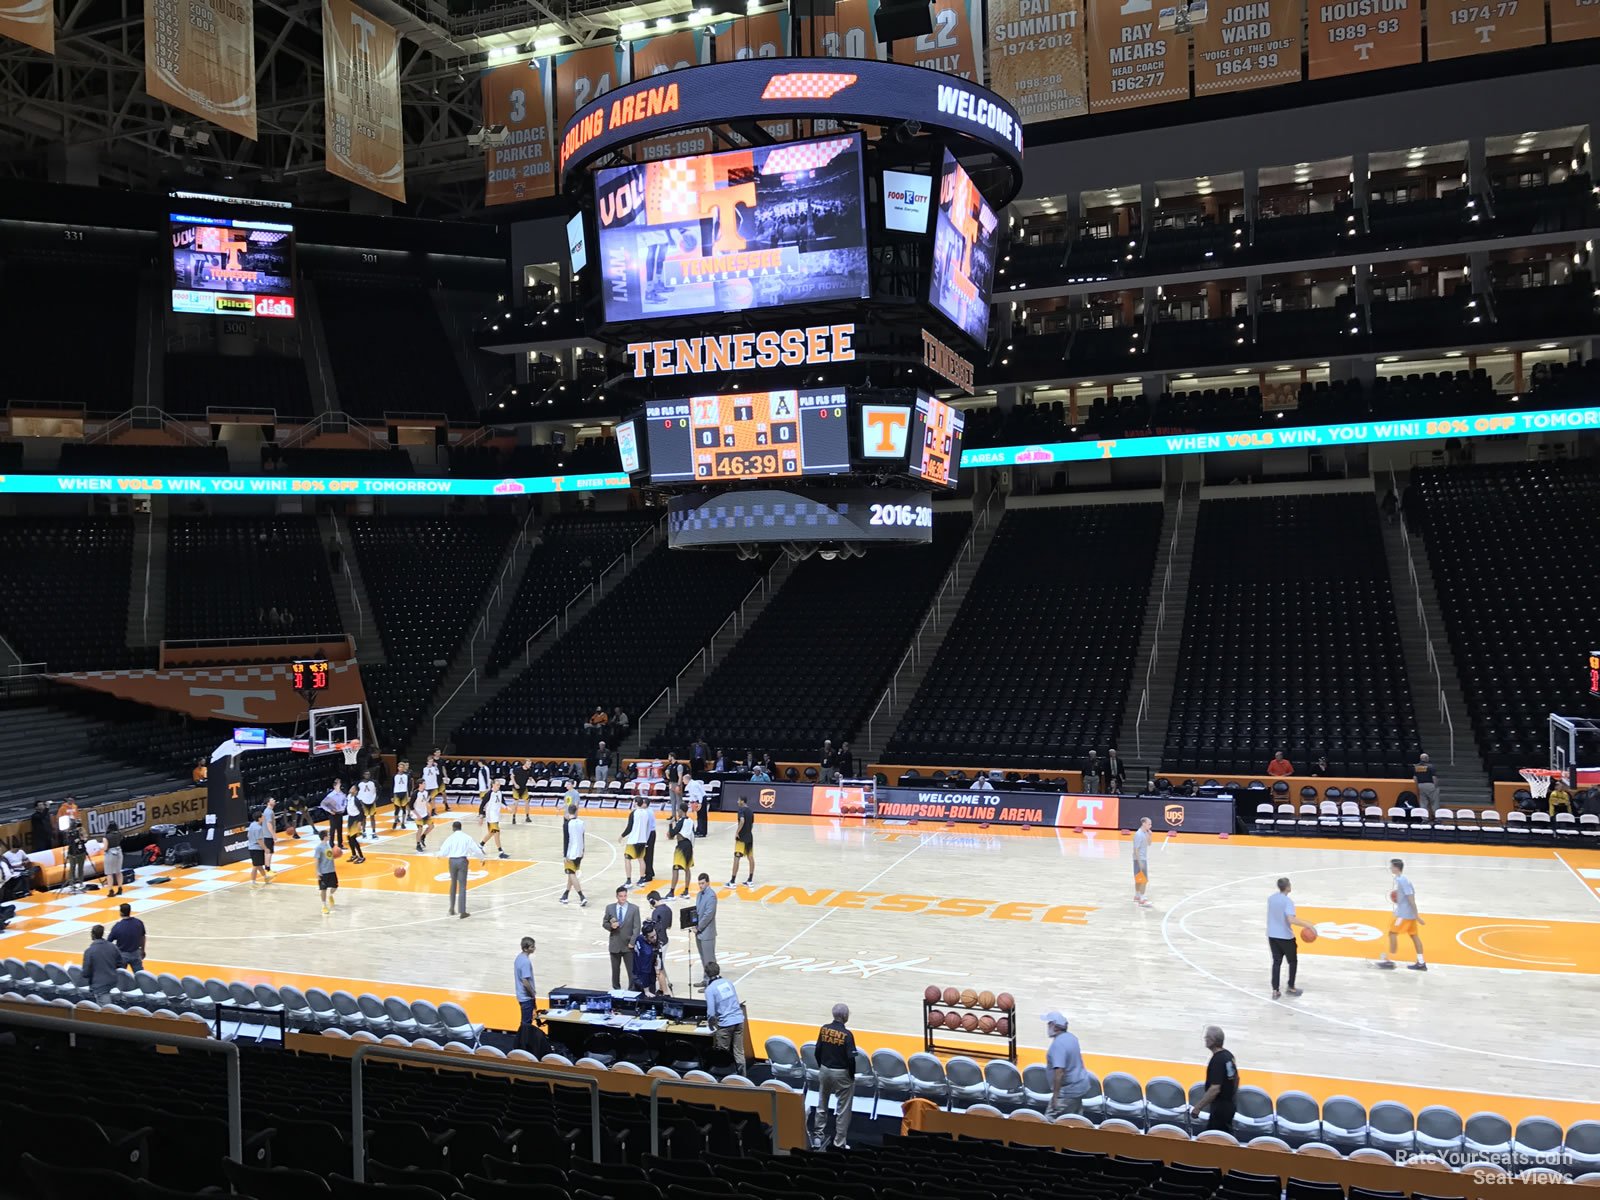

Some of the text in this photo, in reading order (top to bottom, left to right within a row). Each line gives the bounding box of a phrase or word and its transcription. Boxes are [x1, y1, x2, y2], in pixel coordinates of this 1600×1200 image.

[1222, 2, 1269, 25] JOHN
[1321, 0, 1407, 23] HOUSTON
[1450, 1, 1518, 24] 1974-77
[995, 11, 1077, 41] SUMMITT
[1121, 23, 1153, 43] RAY
[1221, 22, 1271, 44] WARD
[1328, 18, 1399, 42] 1989-93
[1003, 33, 1072, 57] 1974-2012
[1109, 41, 1166, 64] MEARS
[1234, 46, 1246, 57] OF
[1248, 44, 1265, 55] THE
[1112, 60, 1164, 77] HEAD COACH
[1215, 54, 1279, 76] 1964-99
[1110, 72, 1165, 94] 1962-77
[509, 89, 526, 122] 3
[609, 83, 679, 130] ARENA
[938, 84, 1012, 141] WELCOME
[1017, 97, 1081, 117] MPIONSHIPS
[489, 126, 545, 148] NDACE
[496, 143, 542, 164] PARKER
[888, 191, 904, 200] FOOD
[914, 194, 927, 203] CITY
[700, 182, 757, 252] T
[64, 230, 83, 240] 331
[361, 253, 377, 262] 301
[680, 249, 782, 278] TENNESSEE
[670, 265, 795, 286] BASKETBALL
[257, 298, 293, 316] dish
[225, 322, 246, 334] 300
[627, 323, 855, 378] TENNESSEE
[740, 407, 748, 421] 1
[775, 396, 791, 415] A
[820, 407, 842, 419] 0 0
[664, 418, 687, 429] 0 0
[779, 426, 790, 441] 0
[867, 412, 906, 452] T
[702, 431, 712, 445] 0
[725, 436, 734, 447] 4
[757, 434, 766, 444] 4
[1166, 435, 1220, 451] WHEN
[1226, 432, 1274, 447] VOLS
[1280, 429, 1322, 444] WIN,
[1328, 427, 1367, 441] YOU
[1374, 424, 1420, 438] WIN!
[1425, 420, 1468, 435] 50%
[1474, 417, 1516, 431] OFF
[718, 455, 776, 475] 46:39
[786, 460, 795, 471] 0
[971, 452, 1004, 463] AREAS
[699, 465, 707, 476] 0
[58, 478, 452, 492] WHEN VOLS WIN, YOU WIN! 50% OFF TOMORROW
[576, 478, 604, 488] ENTER
[312, 672, 326, 688] 30
[189, 687, 276, 720] T
[227, 782, 241, 799] T
[918, 792, 1000, 806] WELCOME TO
[151, 797, 207, 819] BASKET
[825, 790, 848, 813] T
[877, 802, 1043, 822] THOMPSON-BOLING ARENA
[1076, 799, 1103, 826] T
[1166, 811, 1182, 823] ups
[821, 1027, 848, 1040] EVENT
[821, 1034, 845, 1046] STAFF
